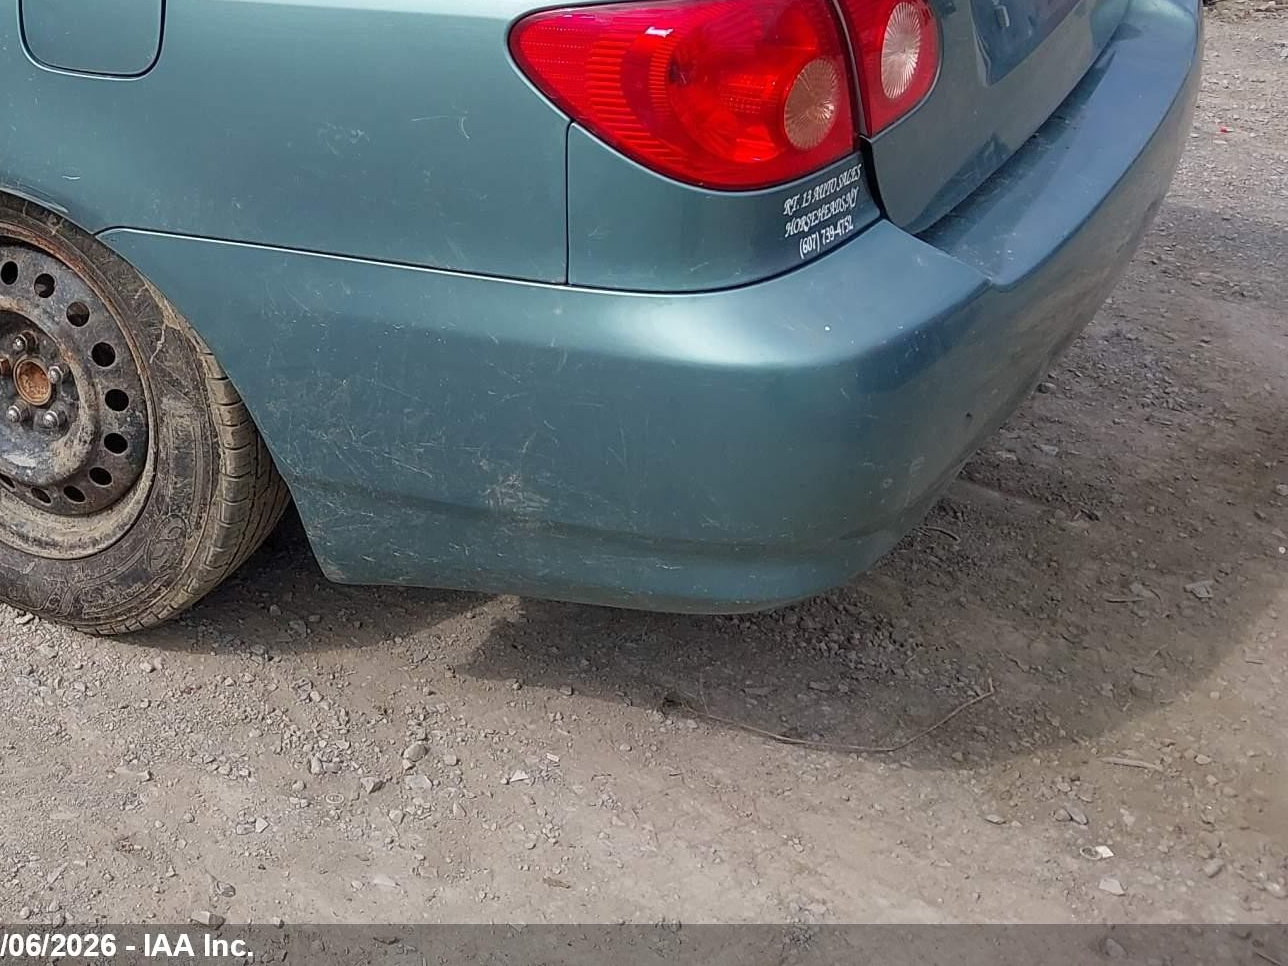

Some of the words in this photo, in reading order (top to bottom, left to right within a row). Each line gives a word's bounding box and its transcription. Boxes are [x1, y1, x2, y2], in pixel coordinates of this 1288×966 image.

[802, 190, 813, 208] 13
[812, 177, 838, 203] AUTO
[836, 164, 862, 190] SALES
[799, 231, 820, 260] (607)
[821, 215, 854, 245] 739-4752
